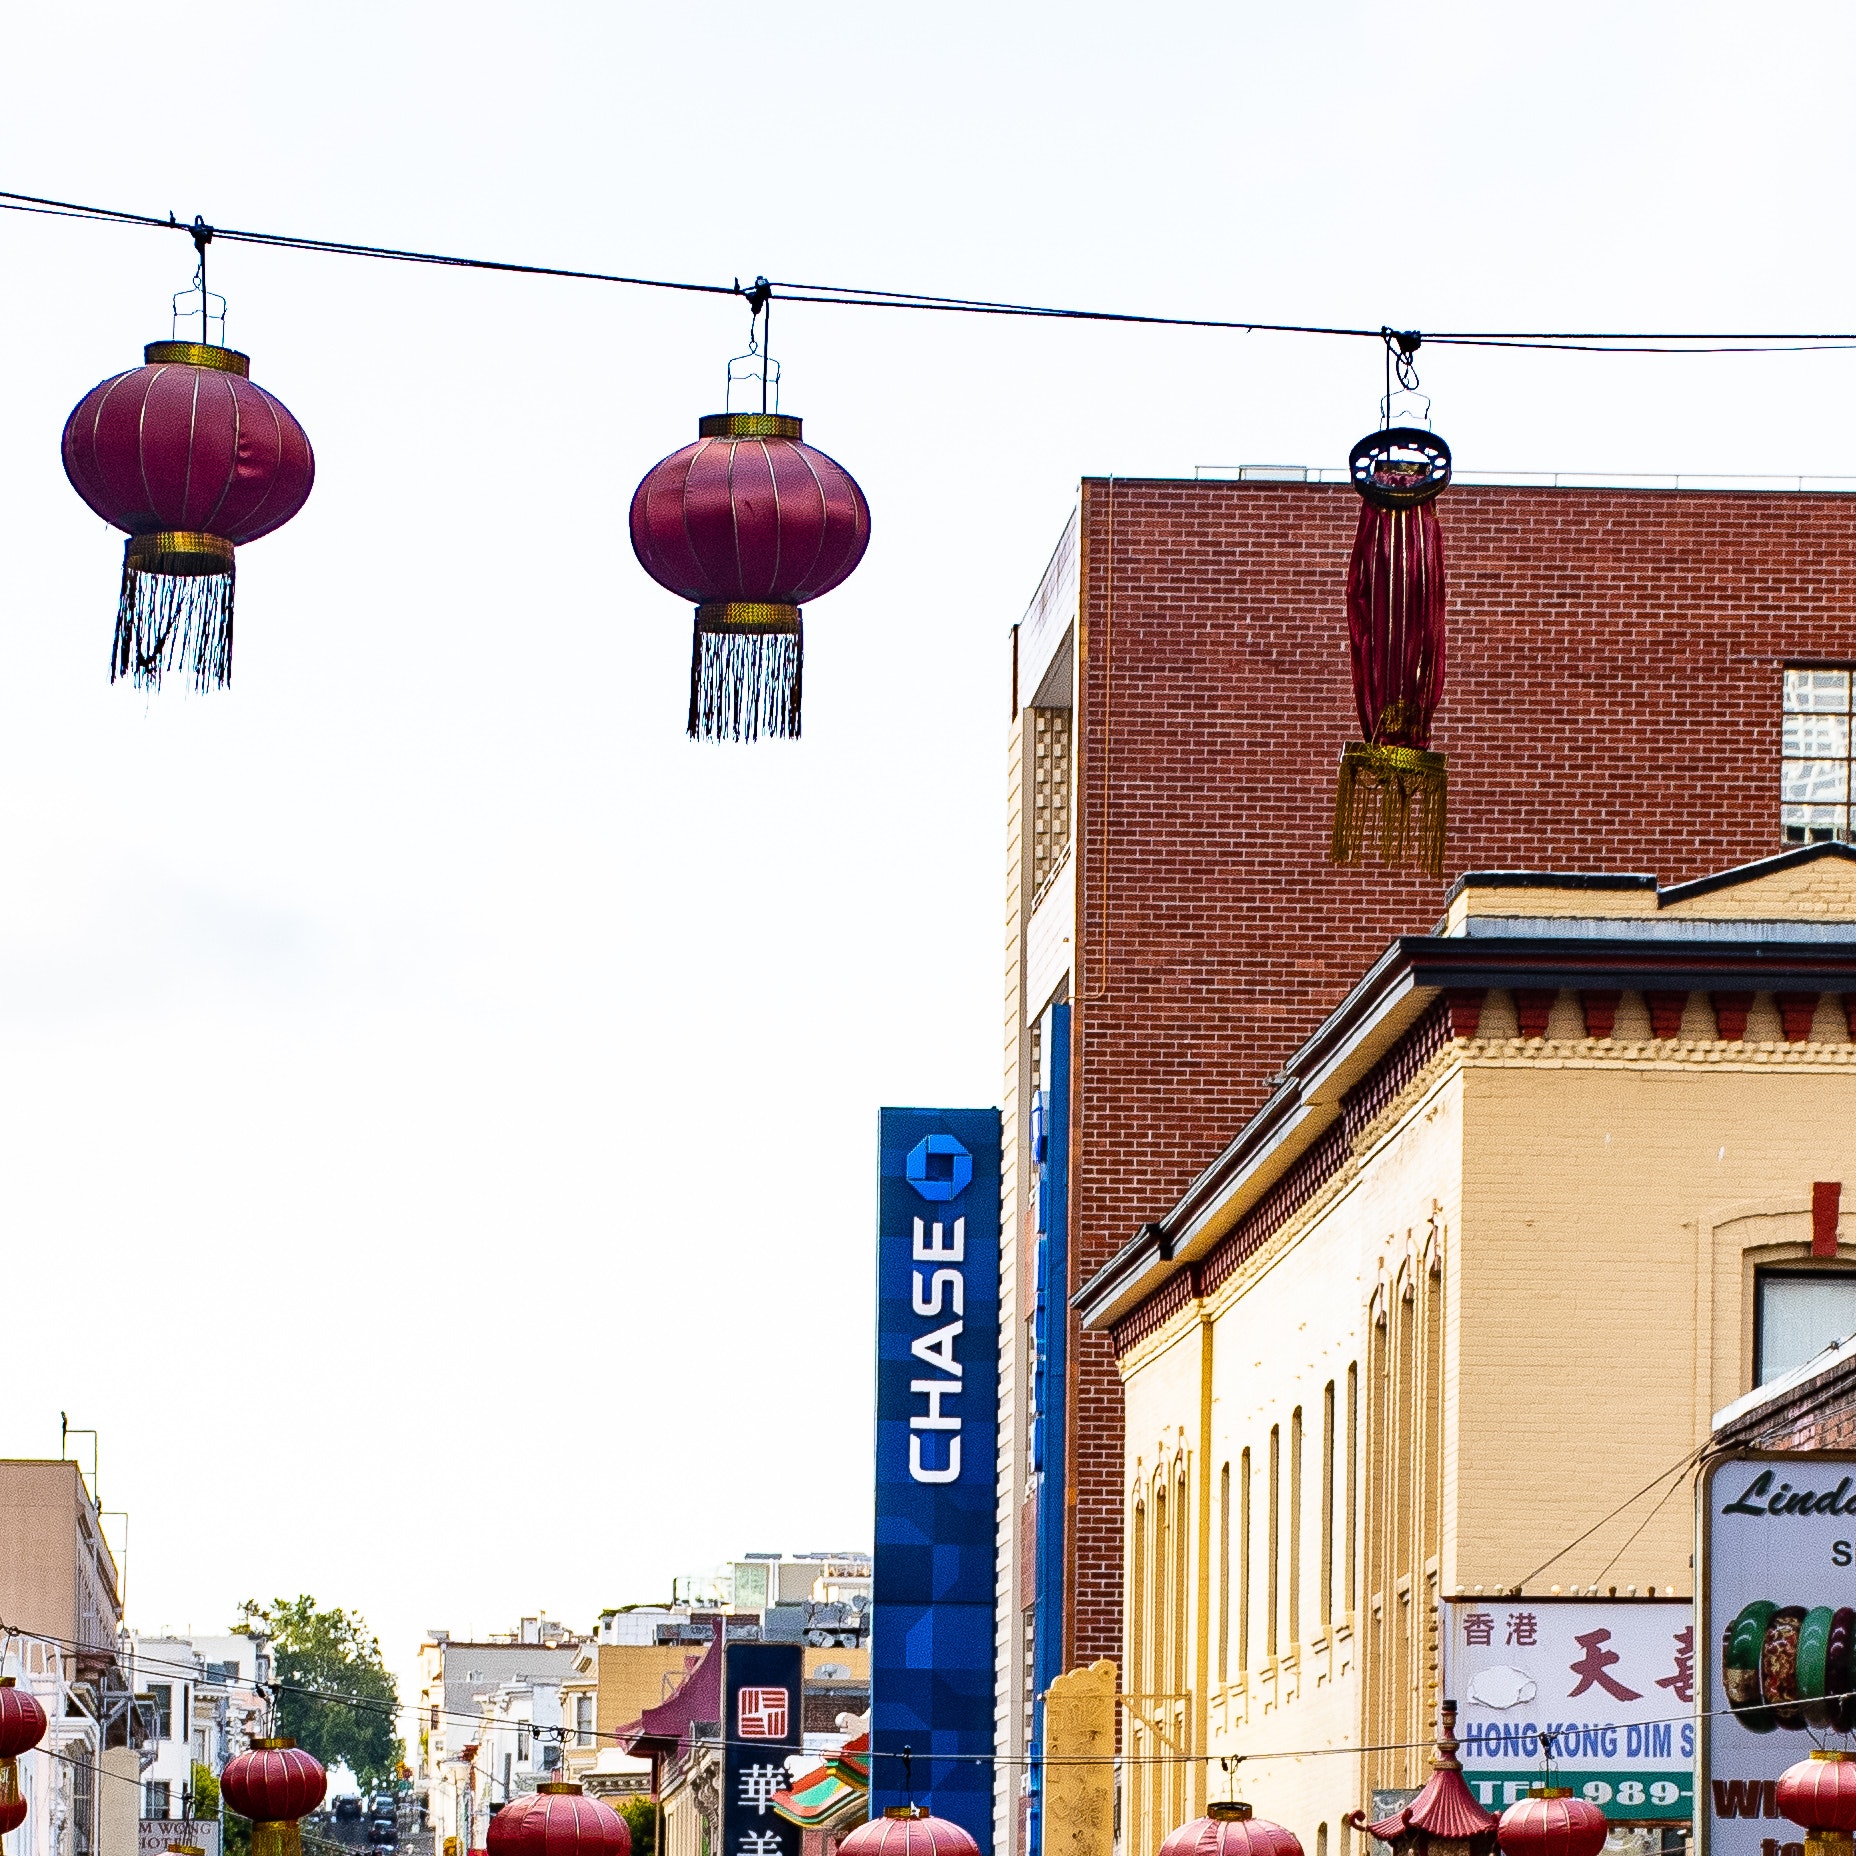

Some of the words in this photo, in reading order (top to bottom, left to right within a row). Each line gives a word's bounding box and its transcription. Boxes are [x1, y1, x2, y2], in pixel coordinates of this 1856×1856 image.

[910, 1218, 963, 1486] CHASE
[1464, 1614, 1536, 1646] 香港
[1467, 1724, 1537, 1757] HONG
[1547, 1724, 1616, 1757] KONG
[1627, 1723, 1671, 1757] DIM
